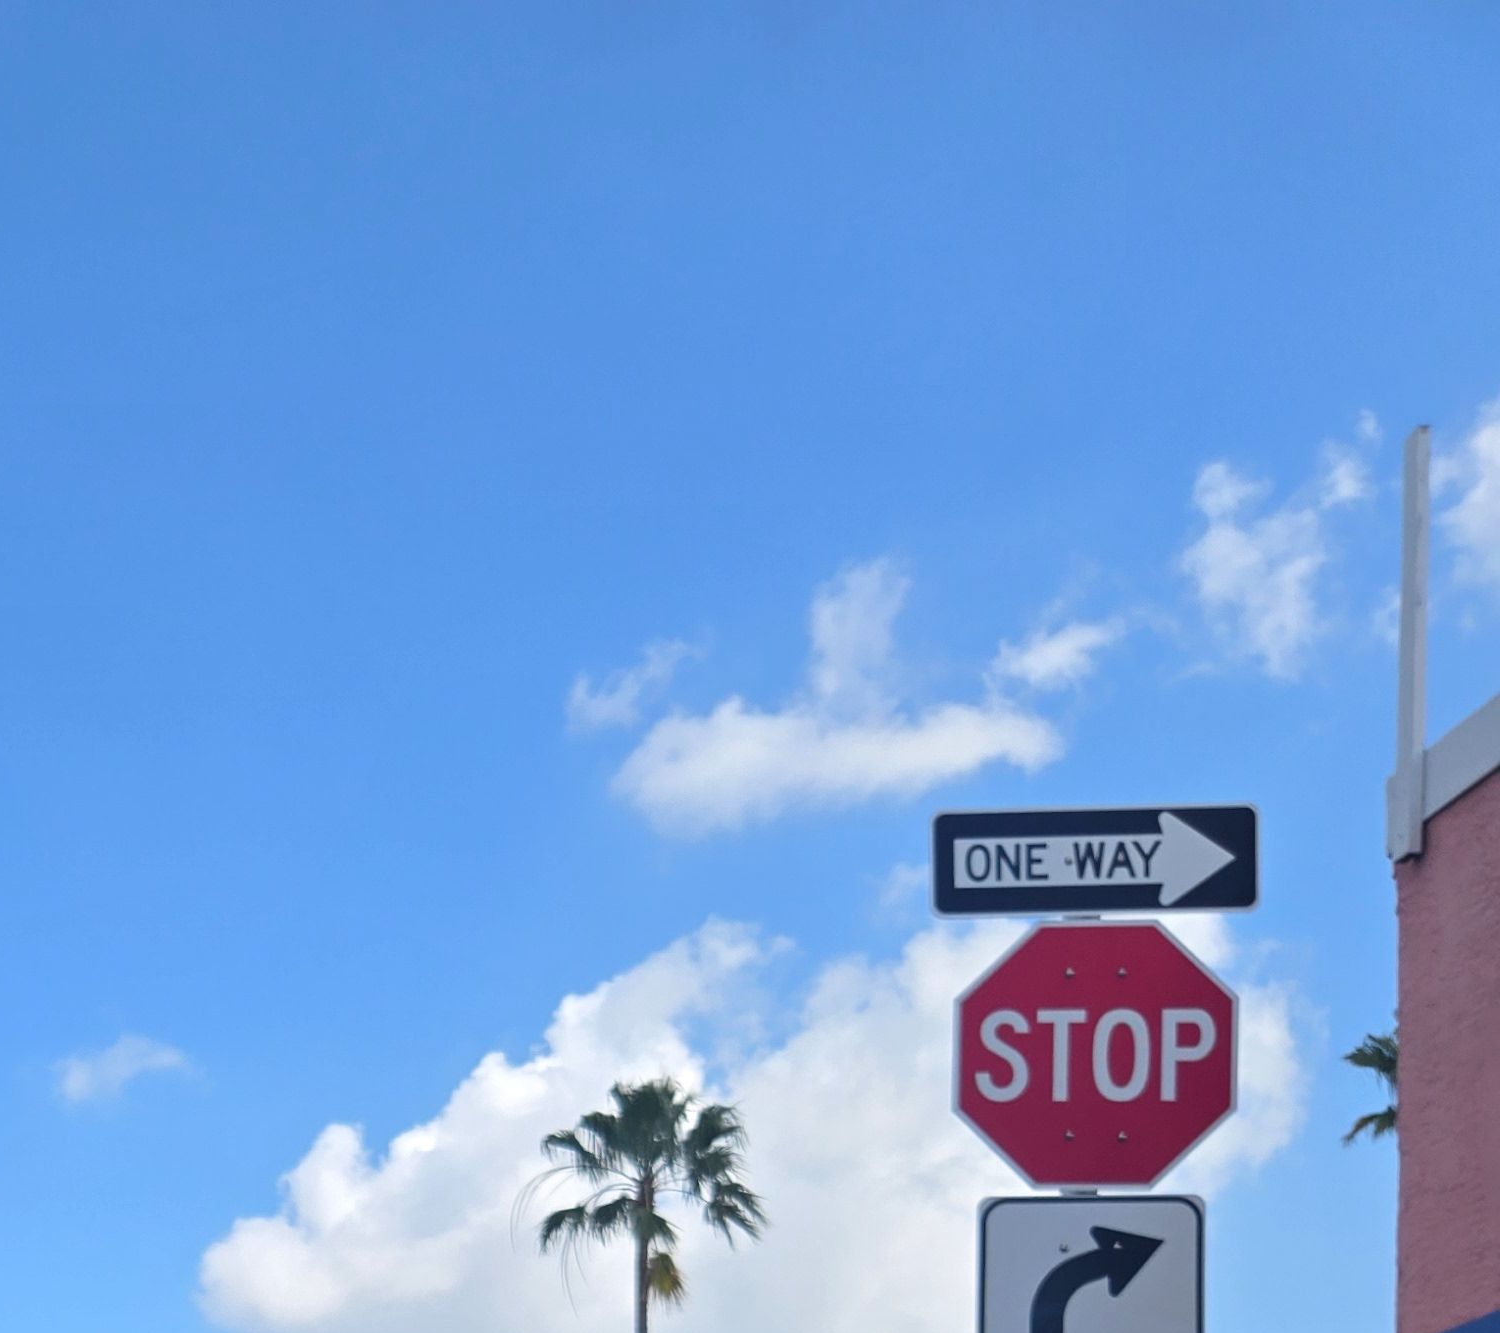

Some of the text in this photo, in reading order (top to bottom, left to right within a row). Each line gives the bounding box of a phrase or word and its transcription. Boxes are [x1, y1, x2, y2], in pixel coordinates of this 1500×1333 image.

[964, 839, 1161, 882] ONE WAY
[974, 1007, 1217, 1104] STOP
